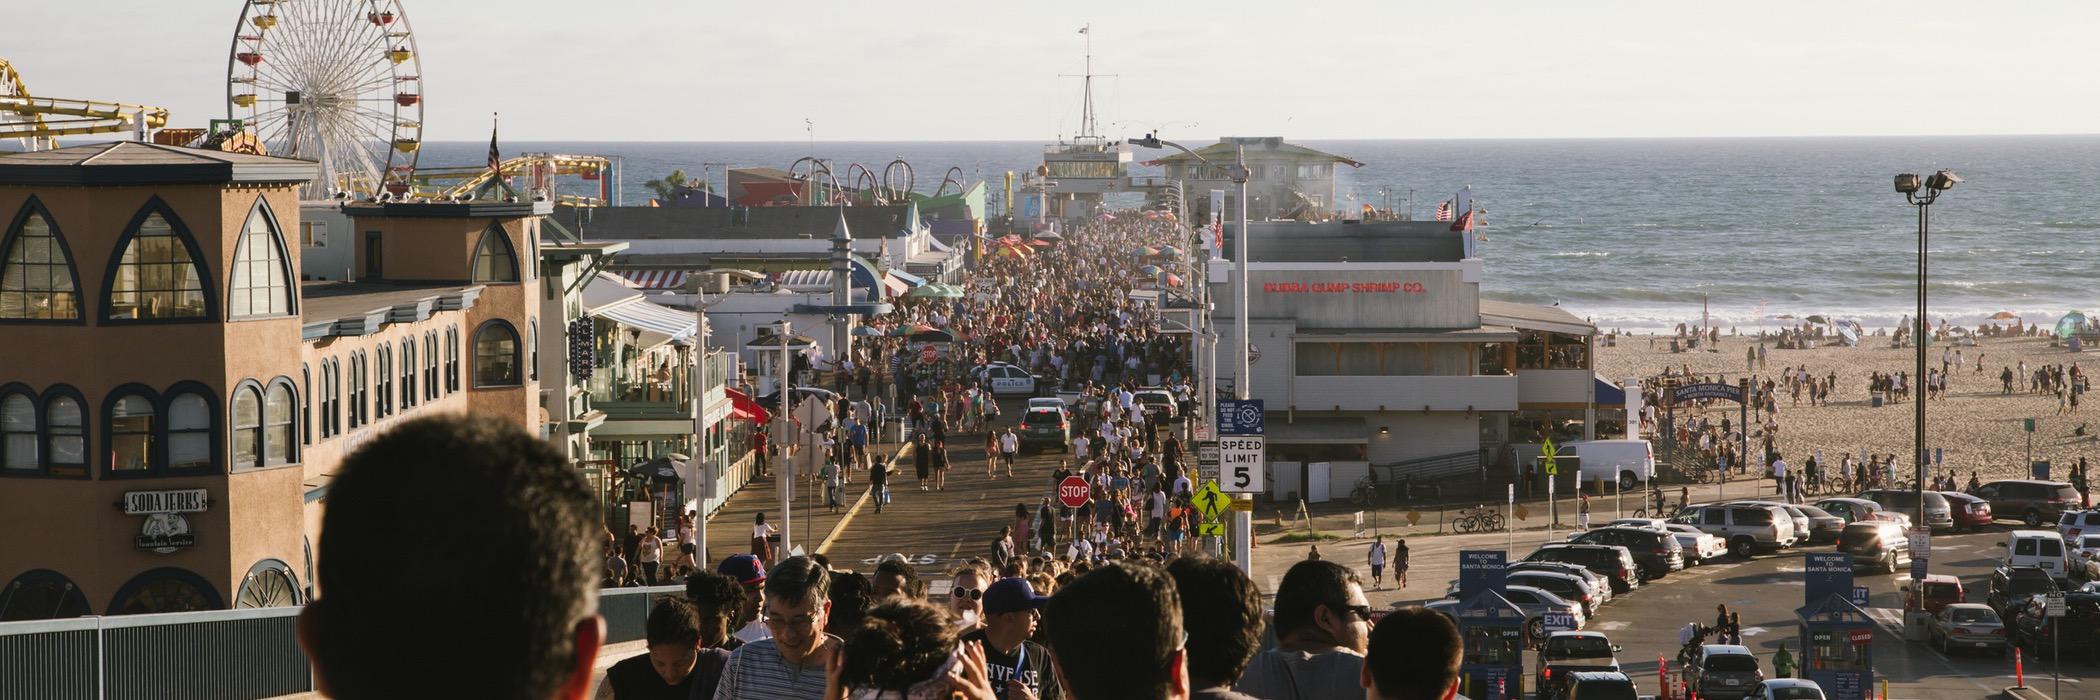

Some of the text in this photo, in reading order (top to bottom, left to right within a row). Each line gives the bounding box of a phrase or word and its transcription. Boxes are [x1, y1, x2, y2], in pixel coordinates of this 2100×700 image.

[1311, 283, 1349, 293] GUMP
[1351, 283, 1400, 293] SHRIMP
[1403, 282, 1427, 293] CO.
[581, 321, 589, 374] AL MARE
[923, 350, 937, 359] STOP
[1676, 384, 1740, 397] SANTA MONICA PIER
[1222, 441, 1261, 450] SPEED
[1225, 454, 1258, 463] LIMIT
[1234, 466, 1251, 488] 5
[1061, 485, 1088, 498] STOP
[131, 492, 199, 512] SODA JERKS
[860, 553, 937, 565] STP
[1853, 588, 1868, 599] IT
[1544, 614, 1572, 626] EXIT
[1851, 633, 1872, 641] CLOSED
[985, 663, 1039, 687] NVESE
